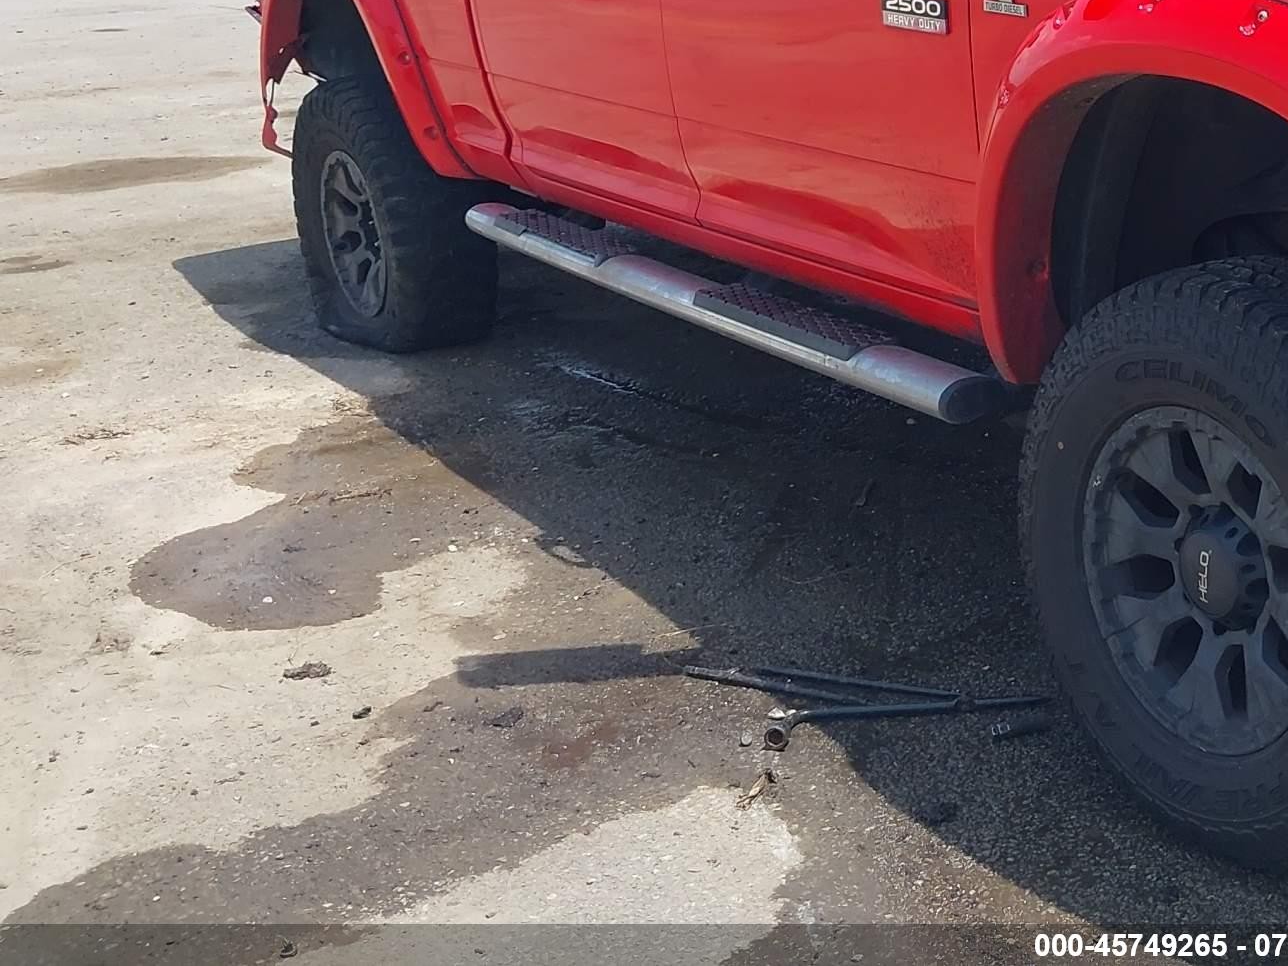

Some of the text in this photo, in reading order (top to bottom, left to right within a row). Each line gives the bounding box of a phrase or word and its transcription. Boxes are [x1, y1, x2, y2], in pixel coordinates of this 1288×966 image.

[887, 14, 941, 31] HEAVY DUTY
[985, 1, 1025, 15] TURBO DIESEL
[1115, 358, 1276, 448] CELIMO
[1198, 550, 1209, 604] HELO
